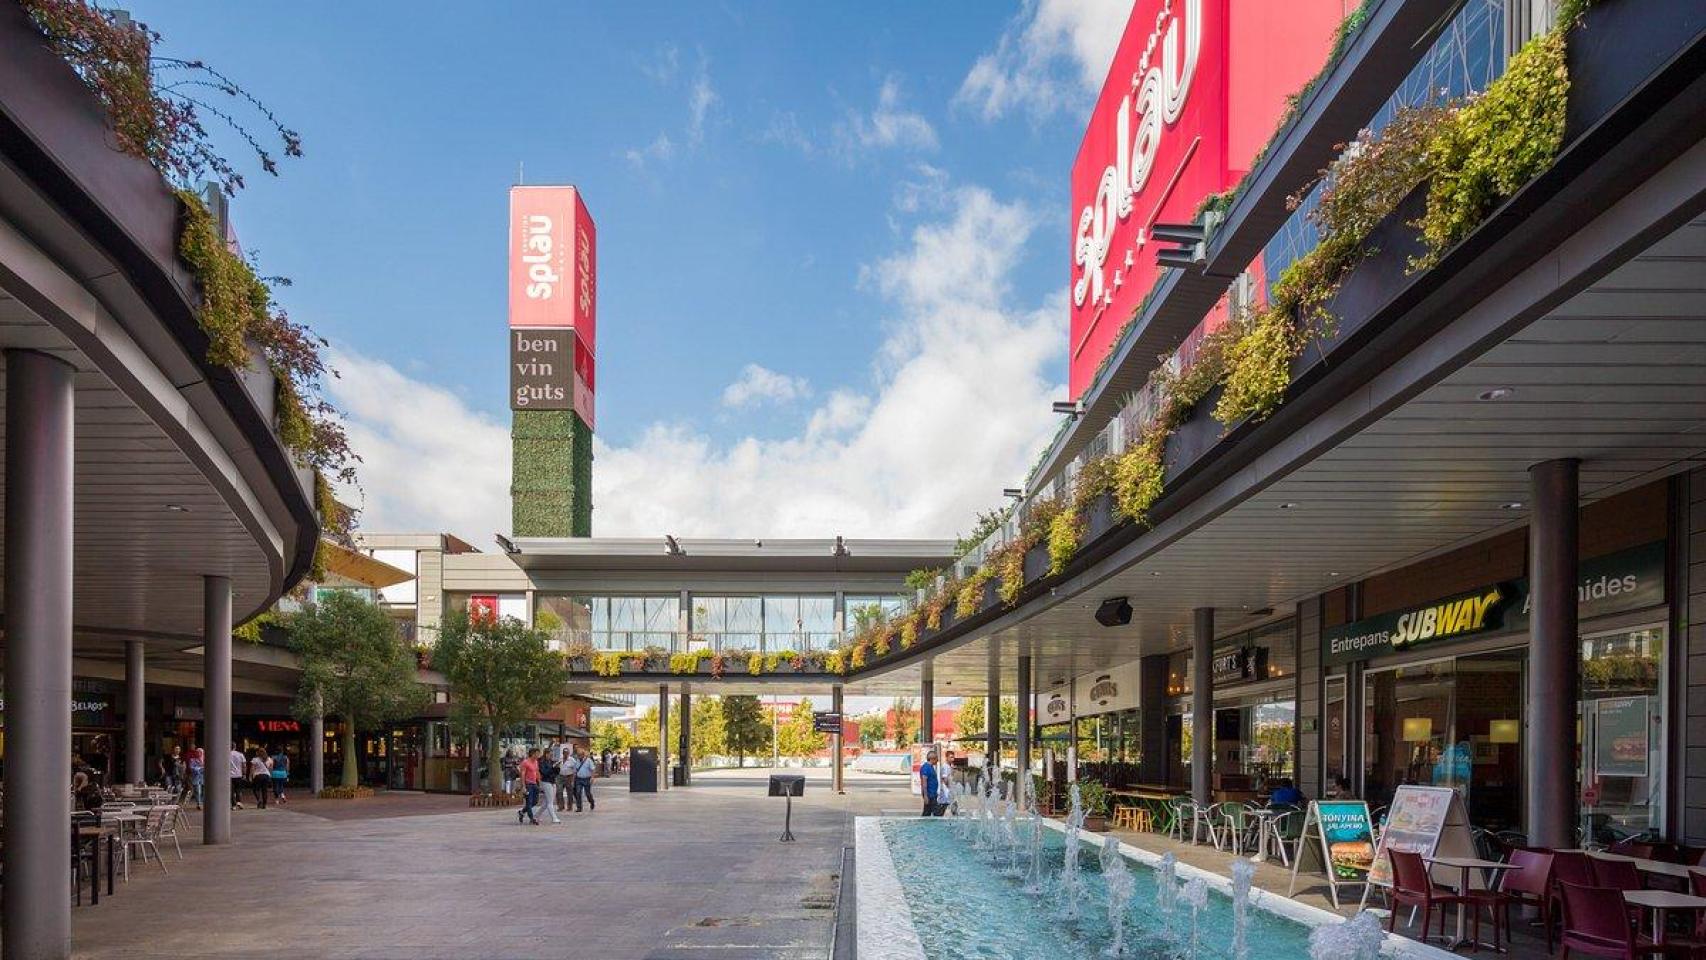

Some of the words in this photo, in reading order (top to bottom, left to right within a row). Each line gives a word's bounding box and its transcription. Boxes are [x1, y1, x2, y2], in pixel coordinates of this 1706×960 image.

[522, 215, 559, 299] splau
[516, 332, 558, 352] ben
[516, 357, 553, 376] vin
[516, 383, 565, 406] guts
[1331, 631, 1390, 654] Entrepans
[1391, 589, 1500, 647] SUBWAY
[258, 720, 300, 731] VIENA
[1323, 814, 1366, 822] TONYINA
